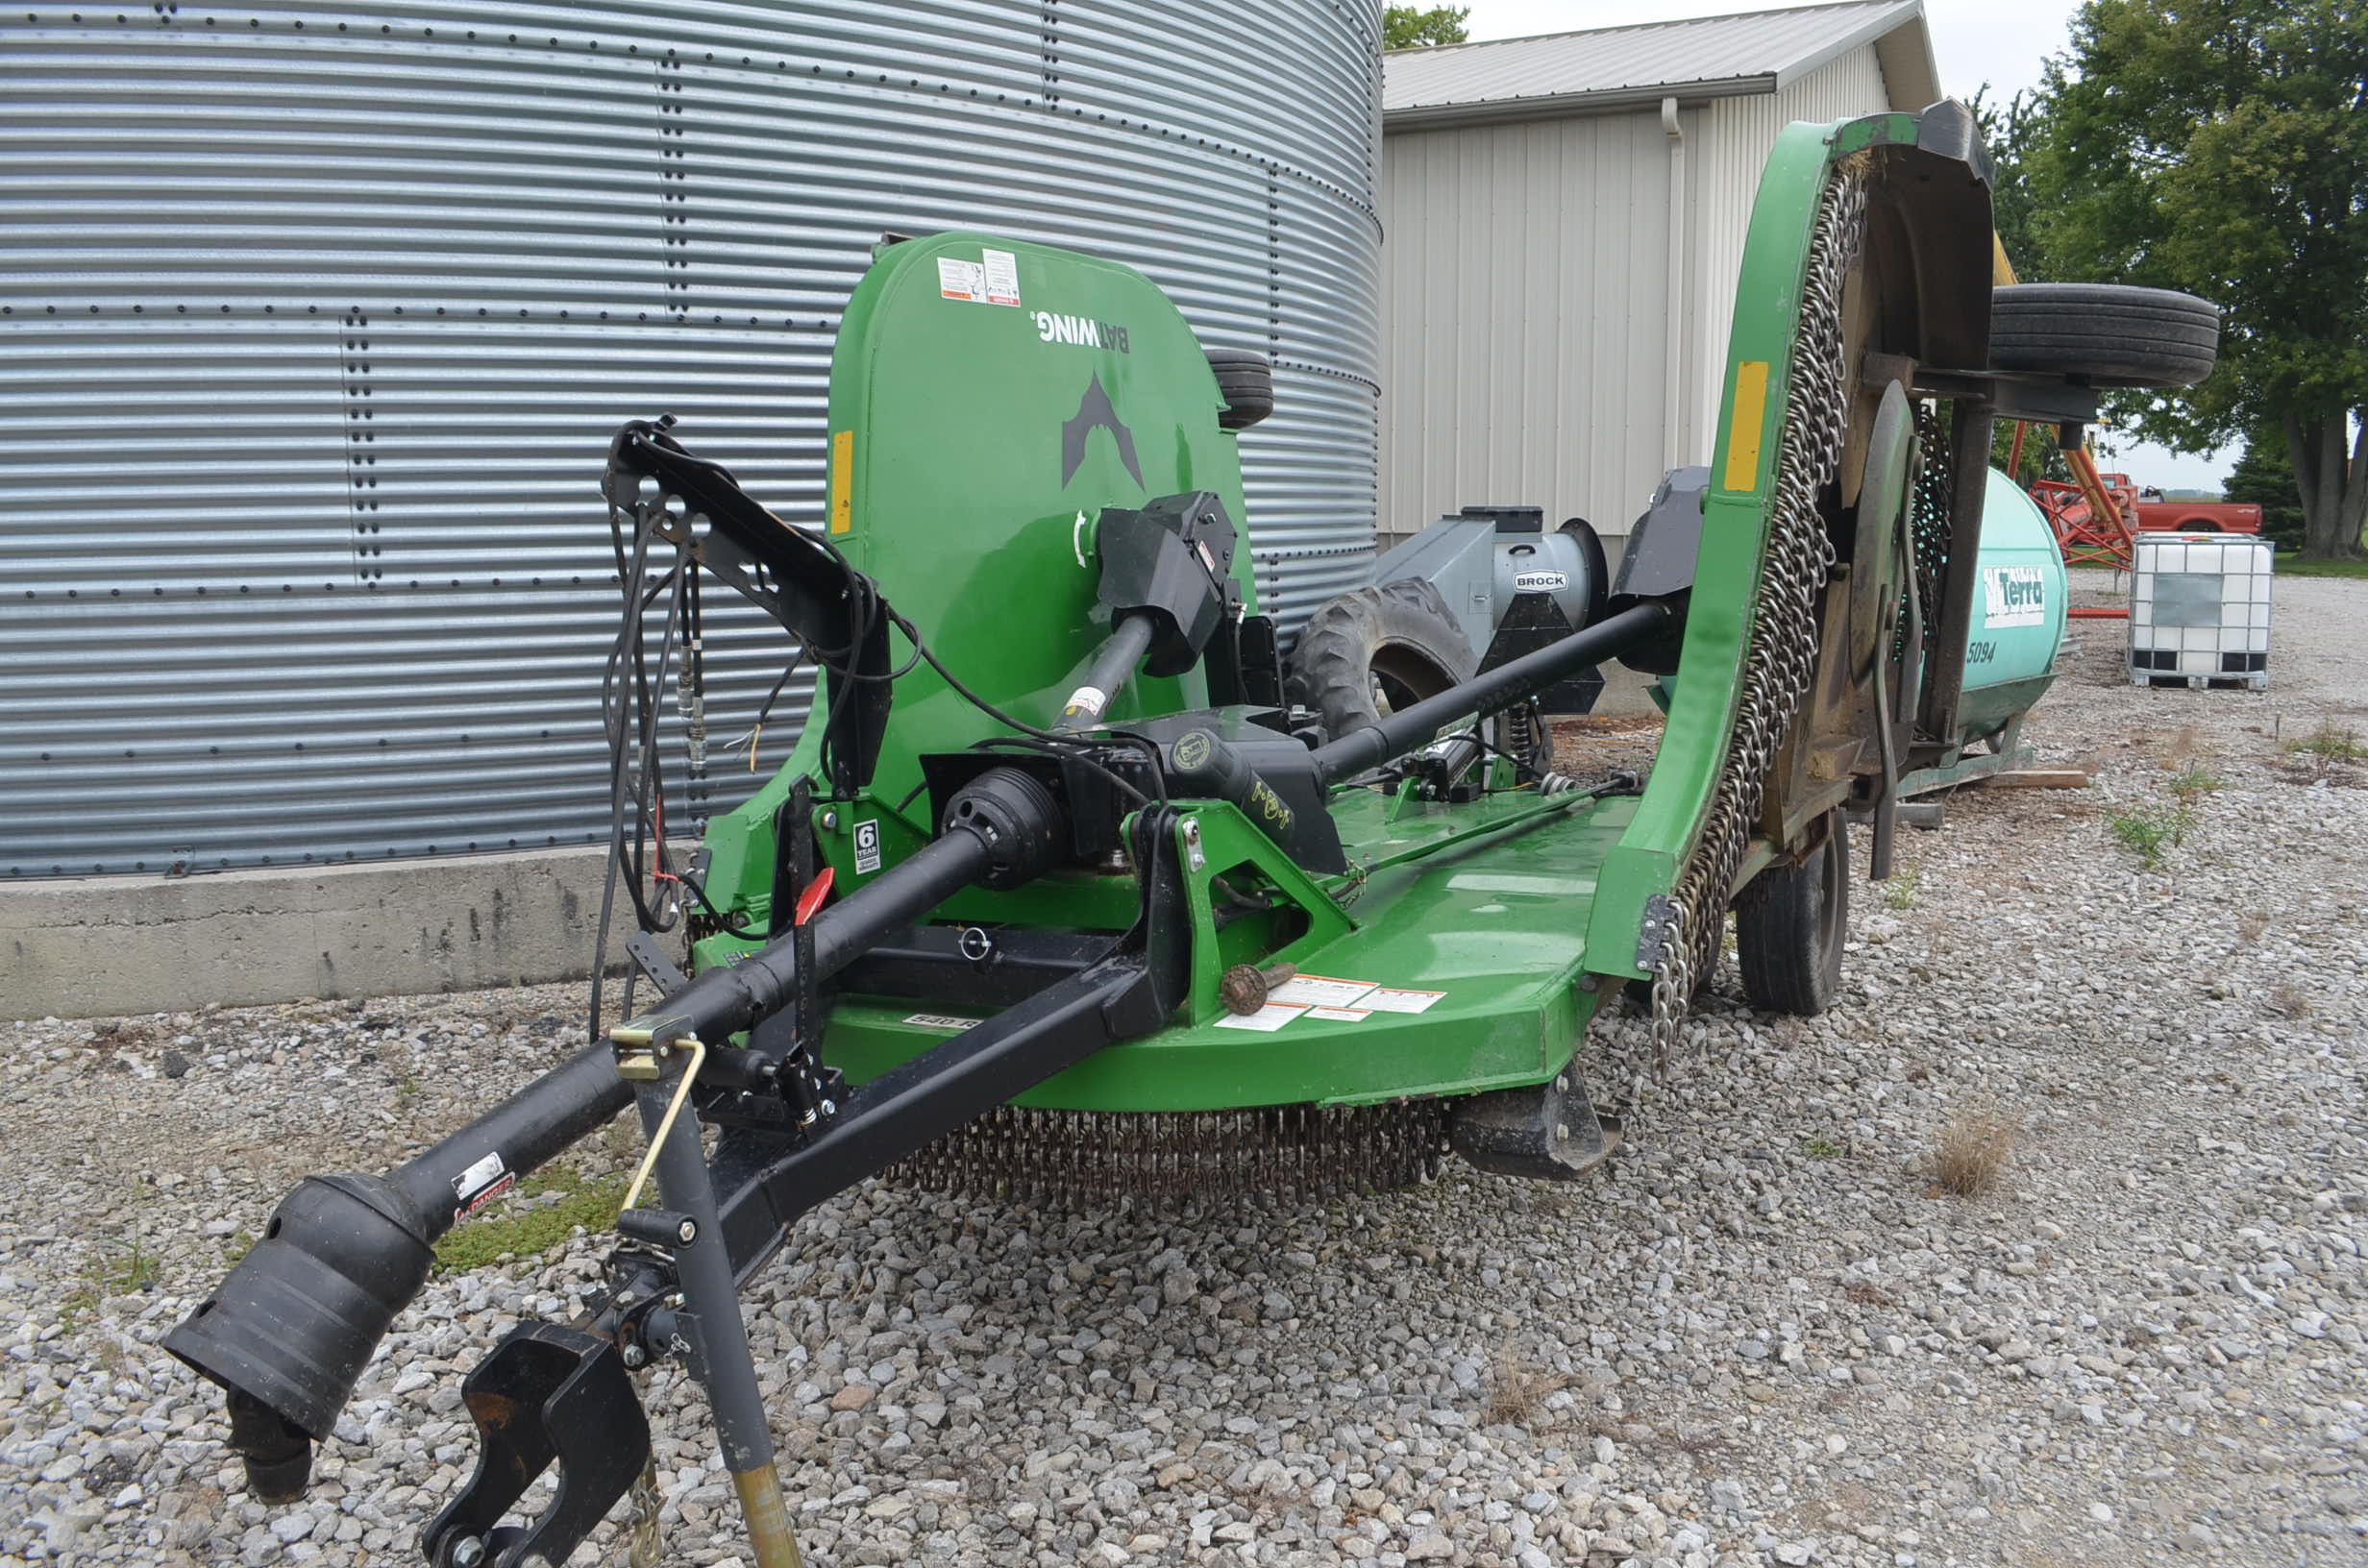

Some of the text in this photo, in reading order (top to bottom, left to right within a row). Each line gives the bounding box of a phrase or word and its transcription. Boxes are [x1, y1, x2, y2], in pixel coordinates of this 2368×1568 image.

[1517, 576, 1565, 586] BROCK
[1998, 572, 2043, 606] Terra
[1966, 641, 1997, 664] 5094
[857, 824, 876, 848] 6
[857, 845, 876, 857] YEAR
